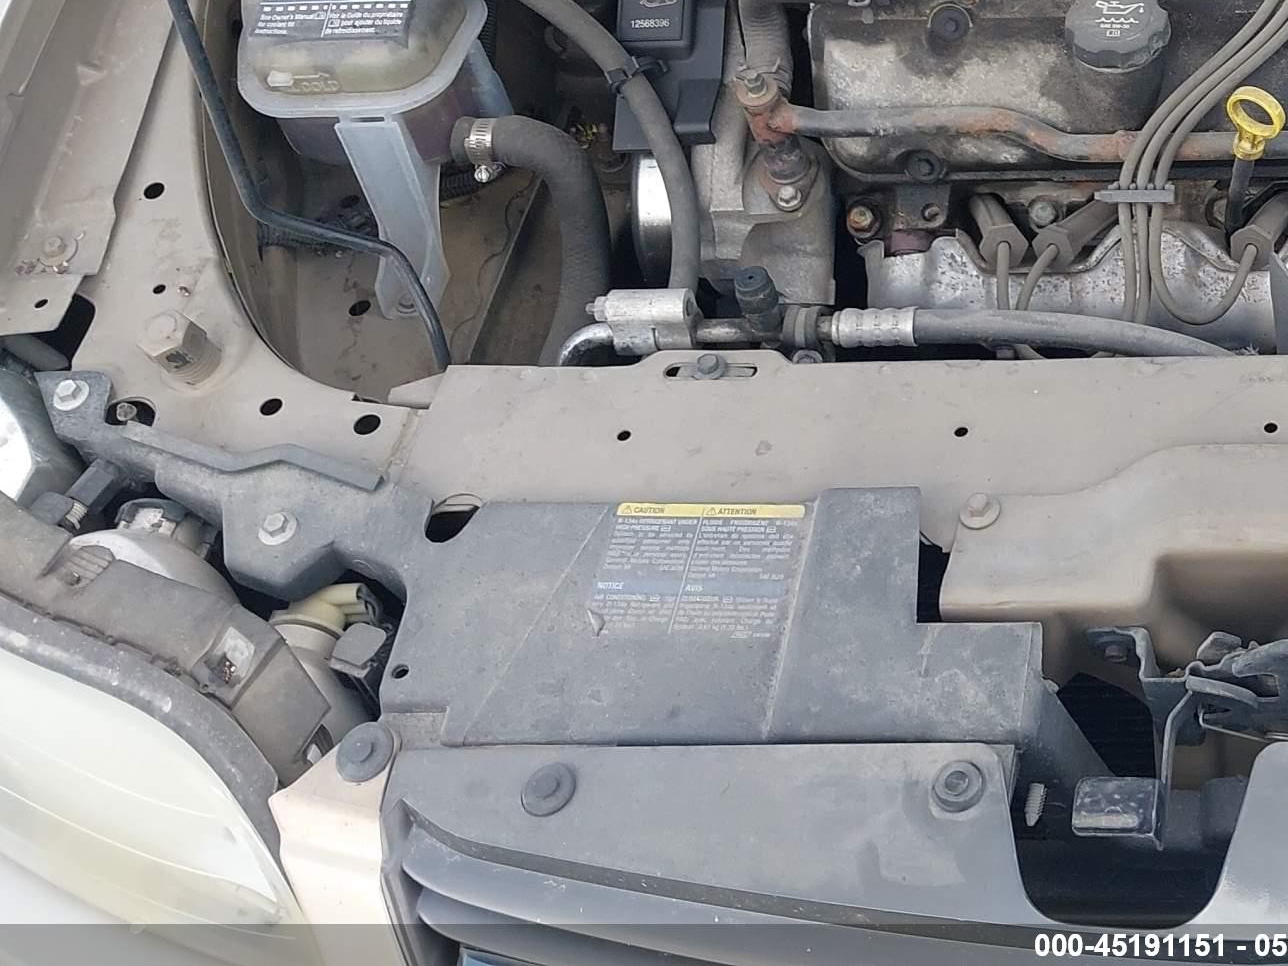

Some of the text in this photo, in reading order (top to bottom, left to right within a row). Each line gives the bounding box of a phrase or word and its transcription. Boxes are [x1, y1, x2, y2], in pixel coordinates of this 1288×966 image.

[630, 18, 670, 29] 12568396
[633, 506, 665, 514] CAUTION
[717, 507, 757, 515] ATTENTION
[596, 581, 625, 590] NOTICE
